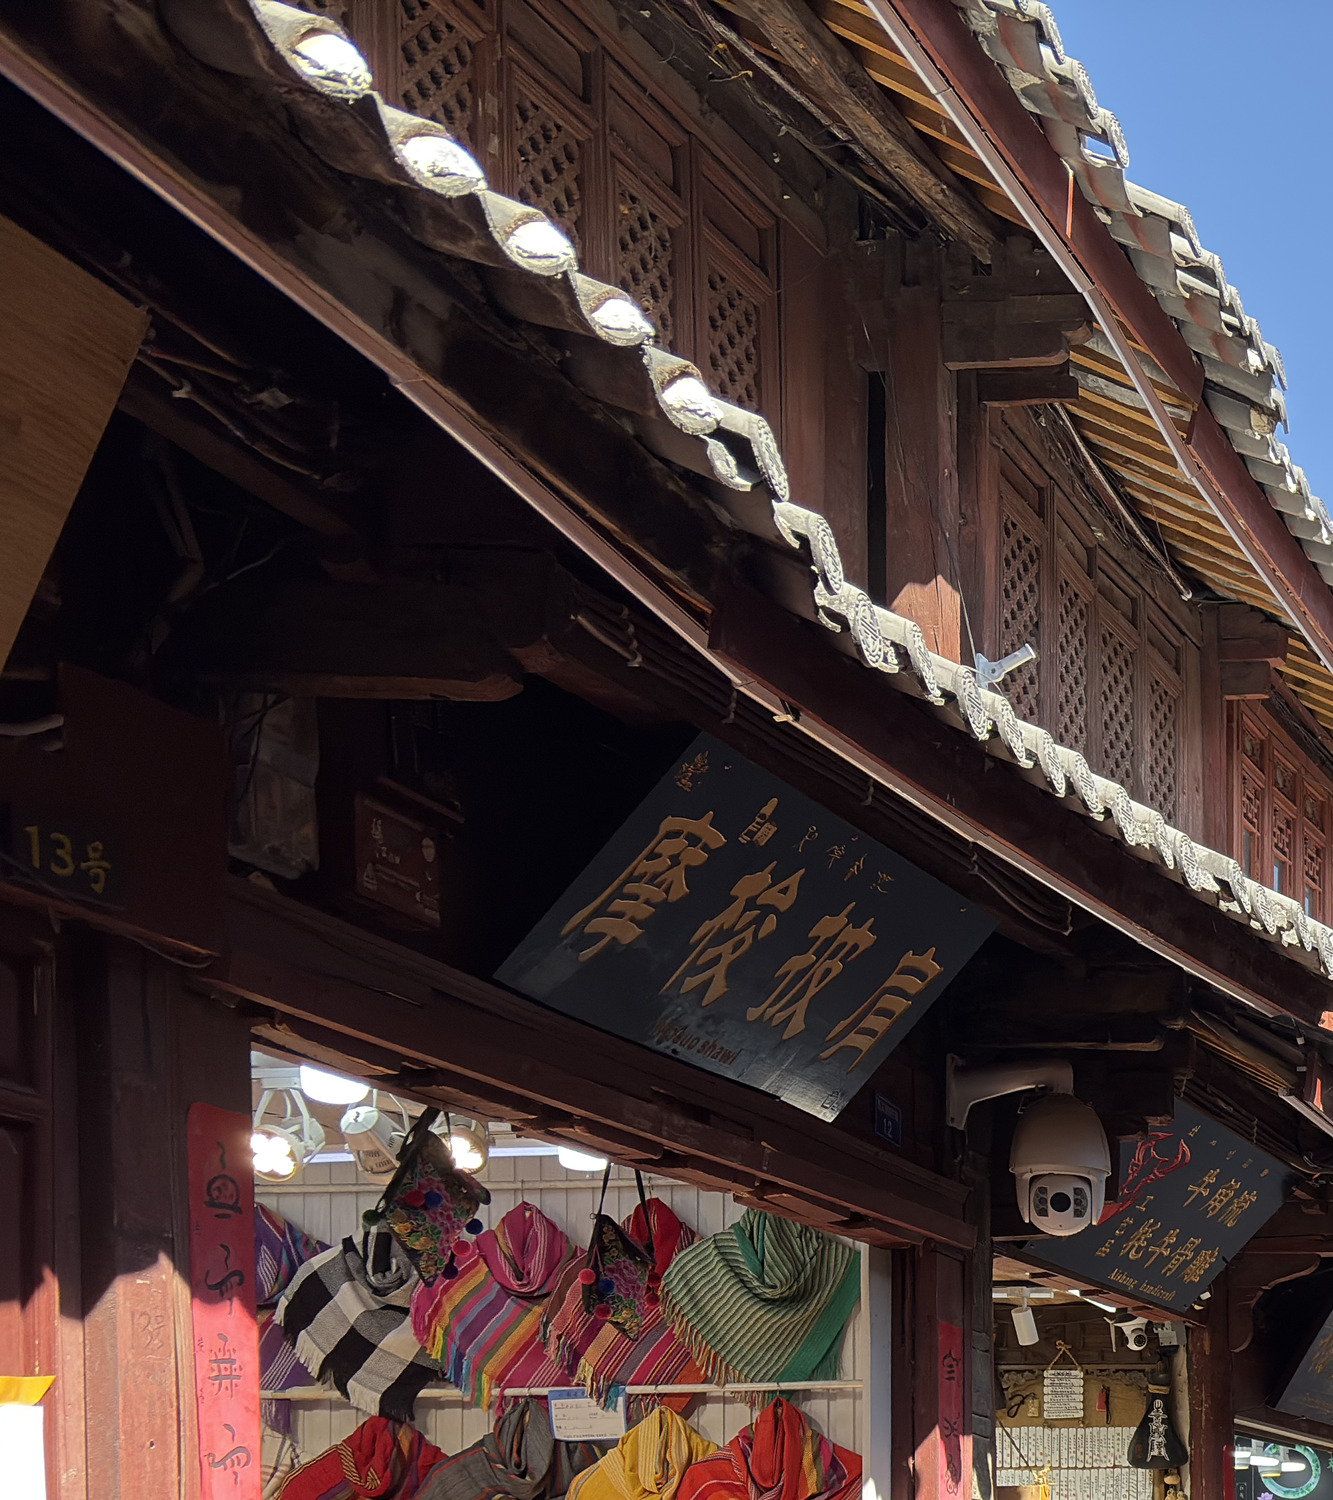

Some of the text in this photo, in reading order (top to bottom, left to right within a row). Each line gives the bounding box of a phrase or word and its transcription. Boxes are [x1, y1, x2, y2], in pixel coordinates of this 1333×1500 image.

[697, 1038, 740, 1066] shawl
[1108, 1268, 1177, 1302] Aishang handicraft
